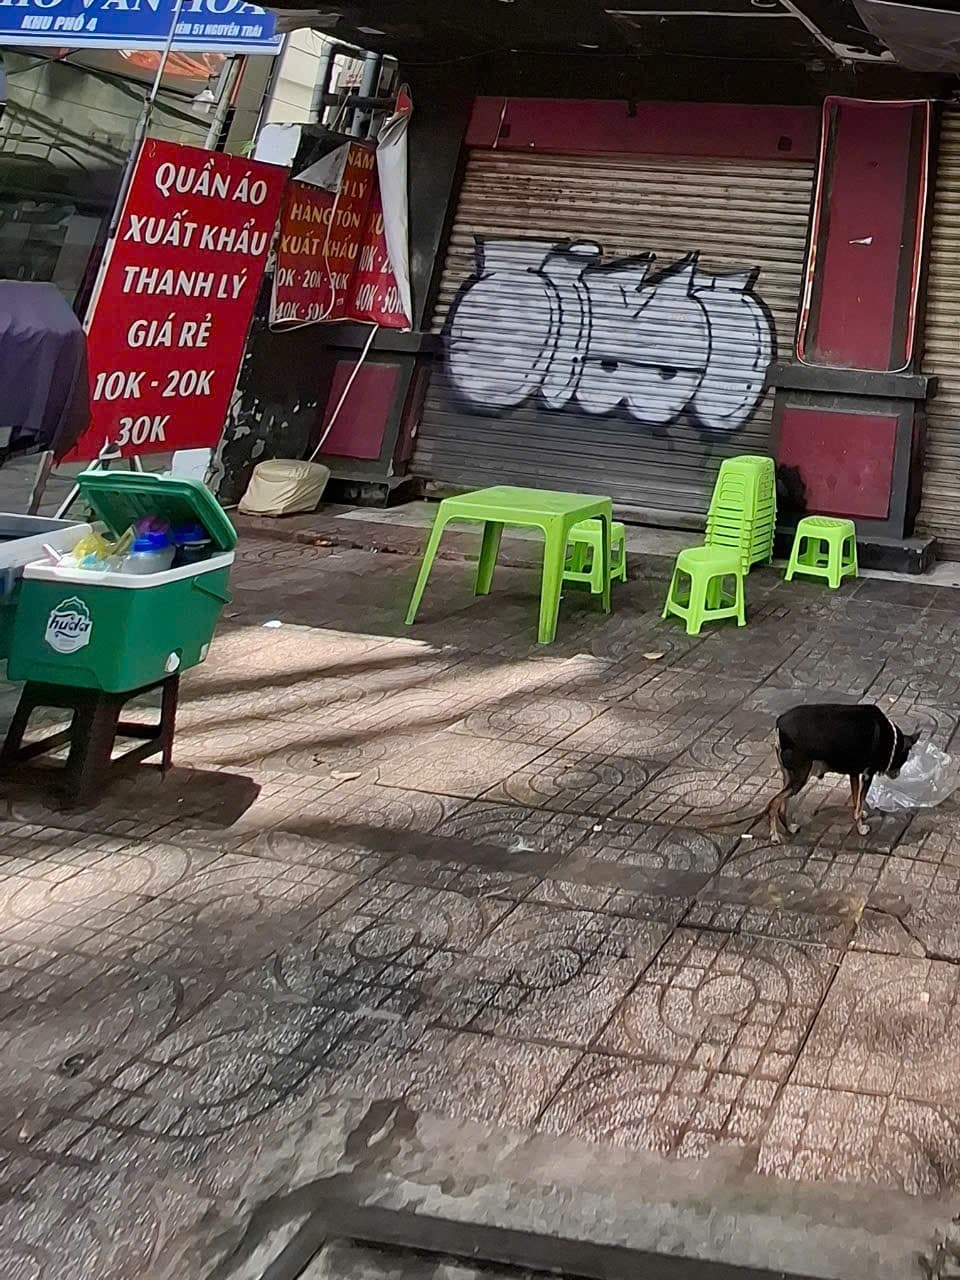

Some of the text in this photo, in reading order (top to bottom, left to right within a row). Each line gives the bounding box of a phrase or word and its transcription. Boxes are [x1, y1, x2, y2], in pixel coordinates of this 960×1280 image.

[20, 14, 54, 30] KHU
[86, 17, 98, 32] 4
[192, 23, 205, 36] 51
[155, 158, 231, 200] QUẦN
[232, 170, 268, 206] ÁO
[124, 209, 268, 257] XUẤT KHẨU
[280, 230, 321, 256] XUẤT
[122, 265, 248, 300] THANH LÝ
[127, 312, 213, 349] GIÁ RẺ
[92, 370, 146, 402] 10K
[161, 369, 216, 399] 20K
[116, 414, 171, 448] 30K
